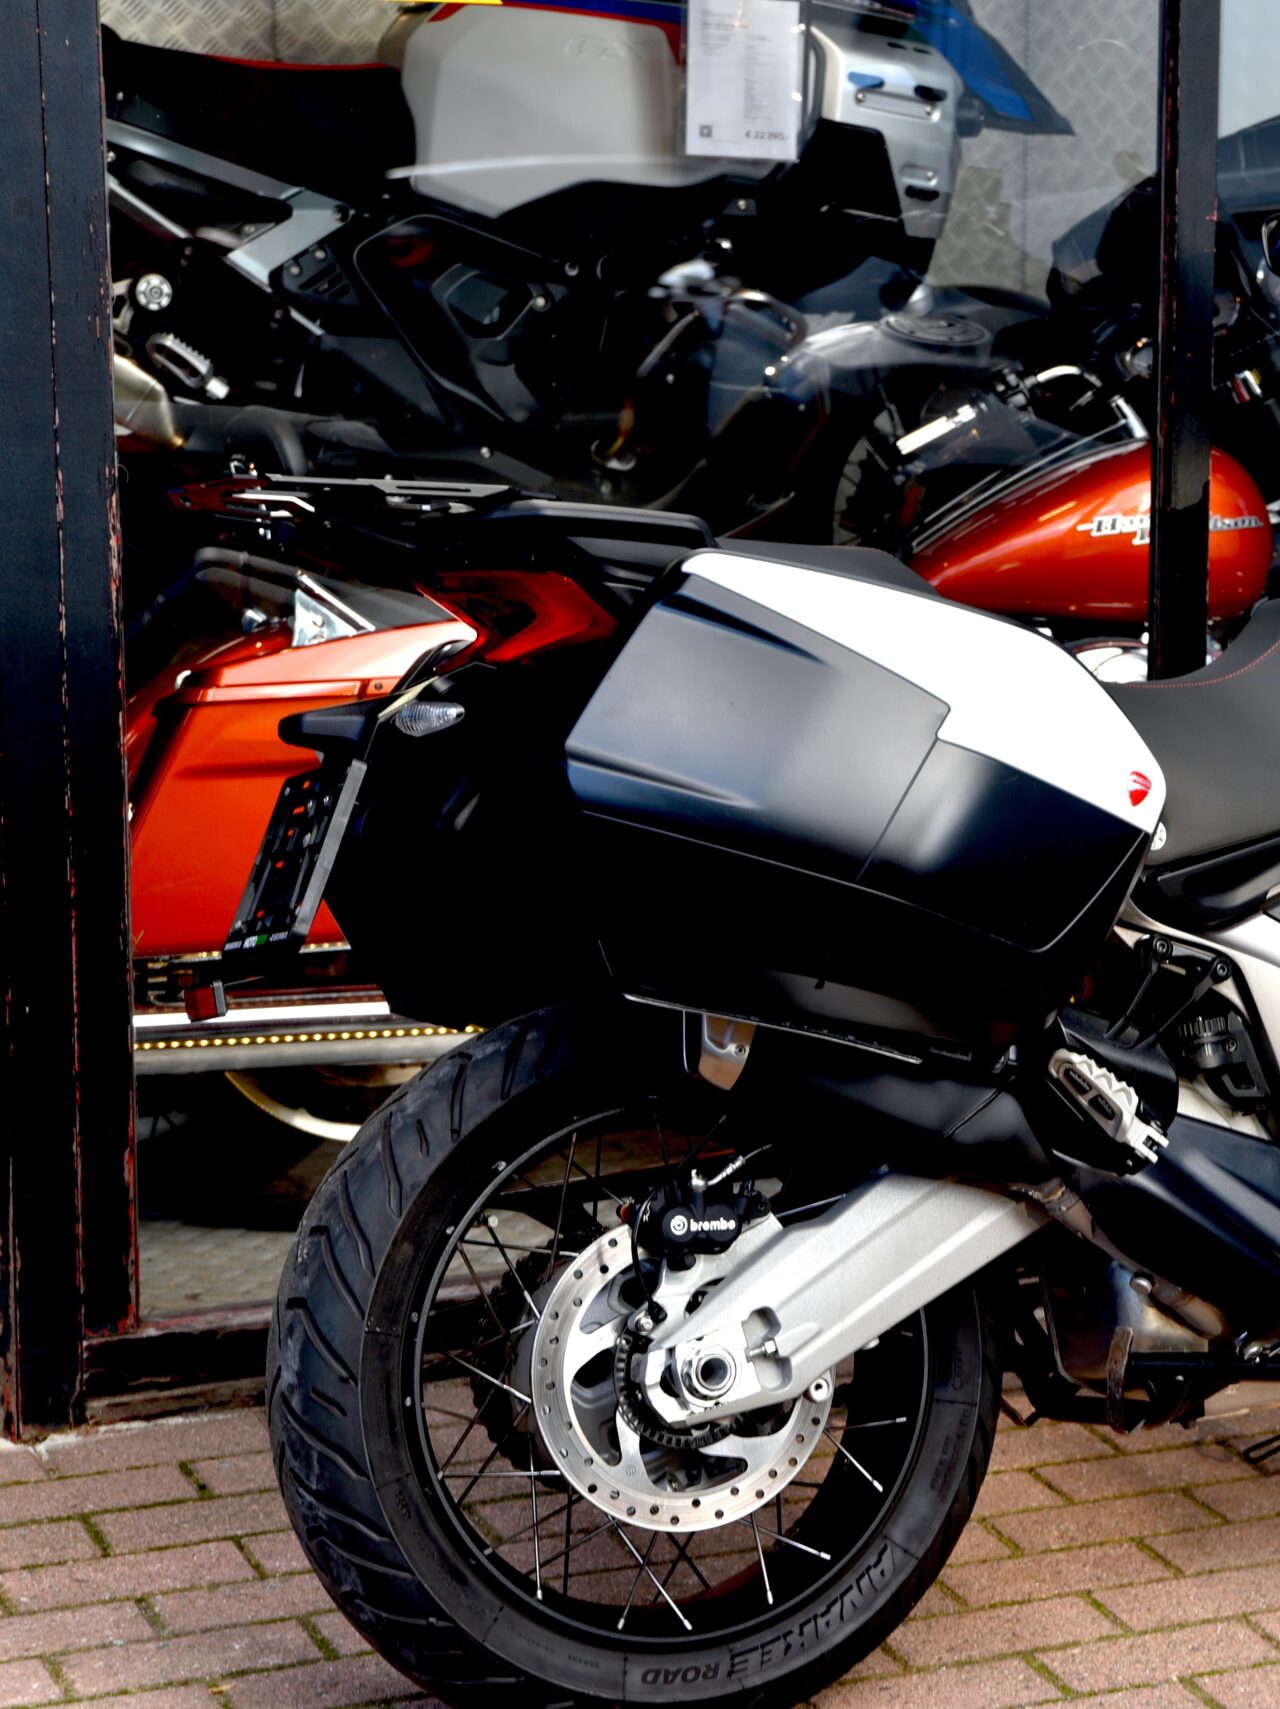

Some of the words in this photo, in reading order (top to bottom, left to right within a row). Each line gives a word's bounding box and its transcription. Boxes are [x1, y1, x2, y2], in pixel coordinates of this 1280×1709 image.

[690, 1217, 736, 1232] brembo
[727, 1542, 897, 1678] ANAKEE
[640, 1661, 720, 1685] ROAD
